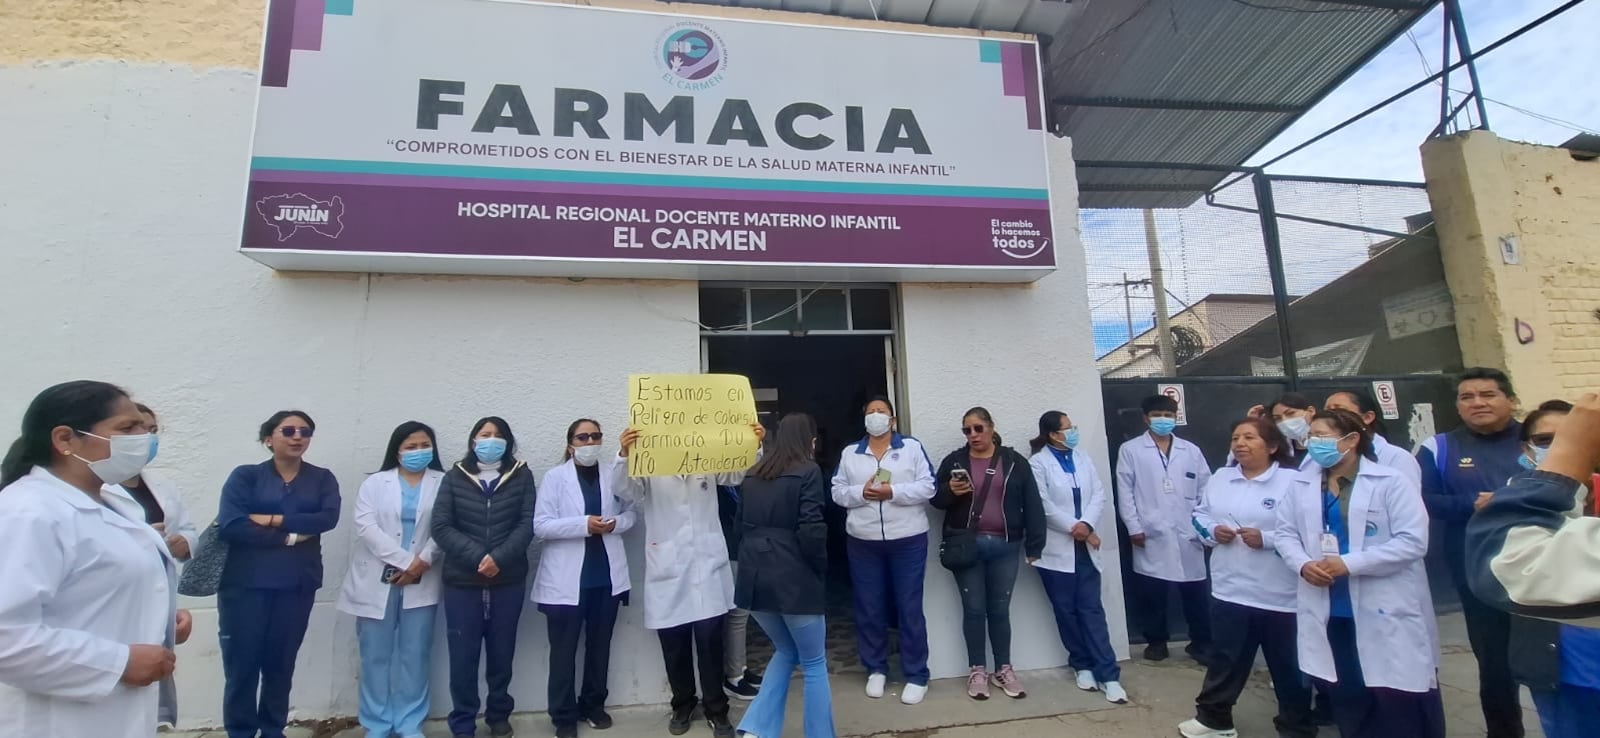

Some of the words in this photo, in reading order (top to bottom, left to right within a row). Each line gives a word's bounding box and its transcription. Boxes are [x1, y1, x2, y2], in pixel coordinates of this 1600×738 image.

[676, 73, 724, 92] CARMEN
[416, 78, 933, 155] FARMACIA
[554, 148, 590, 161] CON
[595, 150, 615, 162] EL
[619, 151, 708, 166] BIENESTAR
[713, 156, 733, 167] DE
[738, 157, 757, 169] LA
[761, 158, 812, 171] SALUD
[816, 160, 885, 174] MATERNA
[457, 201, 551, 220] HOSPITAL
[556, 205, 650, 223] REGIONAL
[655, 209, 739, 226] DOCENTE
[744, 212, 826, 228] MATERNO
[831, 215, 901, 230] INFANTIL
[991, 219, 999, 227] El
[1001, 219, 1033, 228] cambio
[613, 226, 644, 248] EL
[651, 228, 766, 251] CARMEN
[992, 236, 1035, 248] todos
[1001, 228, 1040, 236] hacemos
[637, 376, 713, 401] Estamos
[727, 387, 744, 402] en
[630, 402, 686, 426] Peligro
[693, 408, 709, 425] de
[632, 450, 655, 476] No
[677, 449, 749, 474] Atenderá
